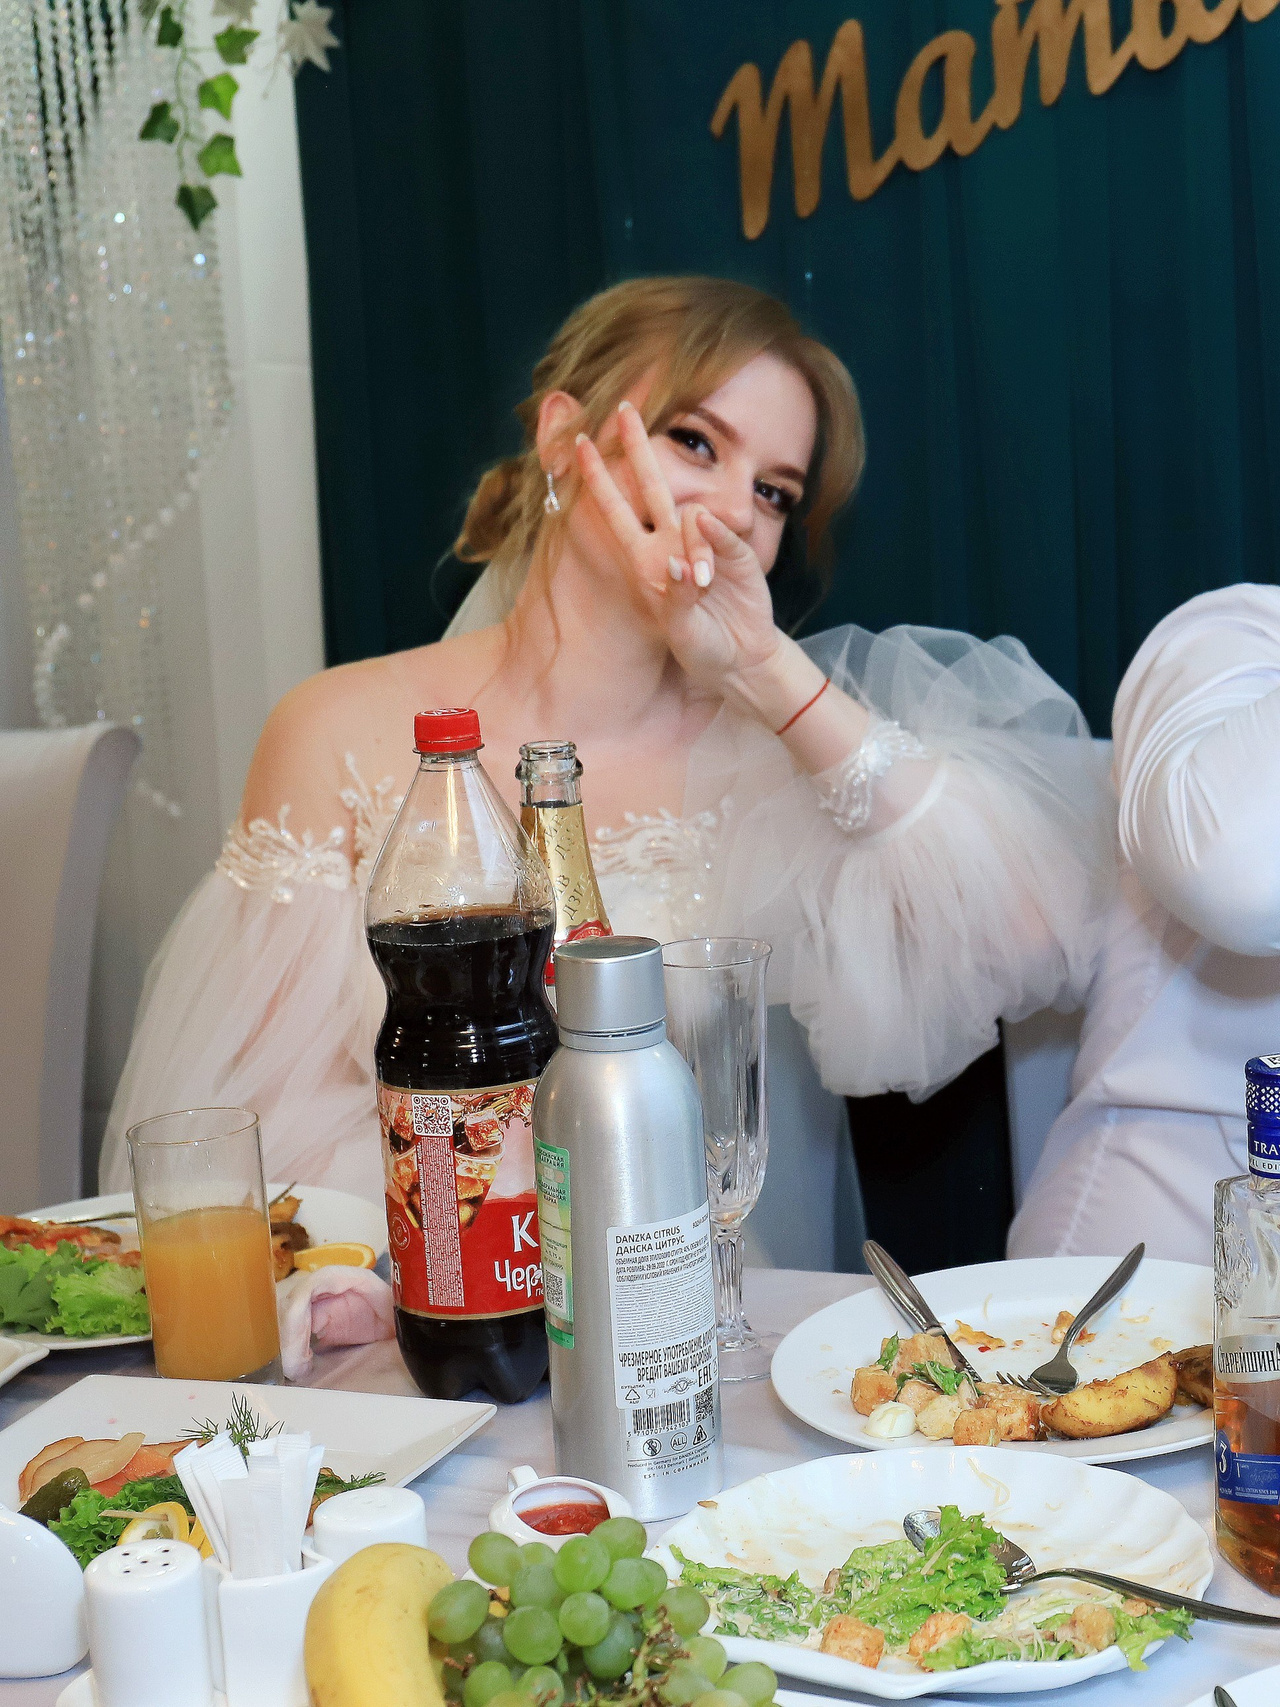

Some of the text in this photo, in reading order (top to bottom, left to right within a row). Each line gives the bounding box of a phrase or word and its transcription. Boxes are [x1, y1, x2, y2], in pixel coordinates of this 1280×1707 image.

[511, 1210, 539, 1253] К
[615, 1225, 681, 1244] DANZKA CITRUS
[616, 1243, 653, 1256] ДАНСКА
[655, 1235, 685, 1250] ЦИТРУС
[494, 1259, 544, 1298] Чер
[619, 1349, 662, 1367] ЧРЕЗМЕРНОЕ
[662, 1335, 702, 1361] УПОТРЕБЛЕНИЕ
[637, 1364, 662, 1384] ВРЕДИТ
[663, 1357, 689, 1377] ВАШЕМУ
[672, 1437, 687, 1447] ALL
[653, 1458, 671, 1466] Germany
[673, 1456, 709, 1473] COPENHAGEN
[1219, 1440, 1227, 1473] 3
